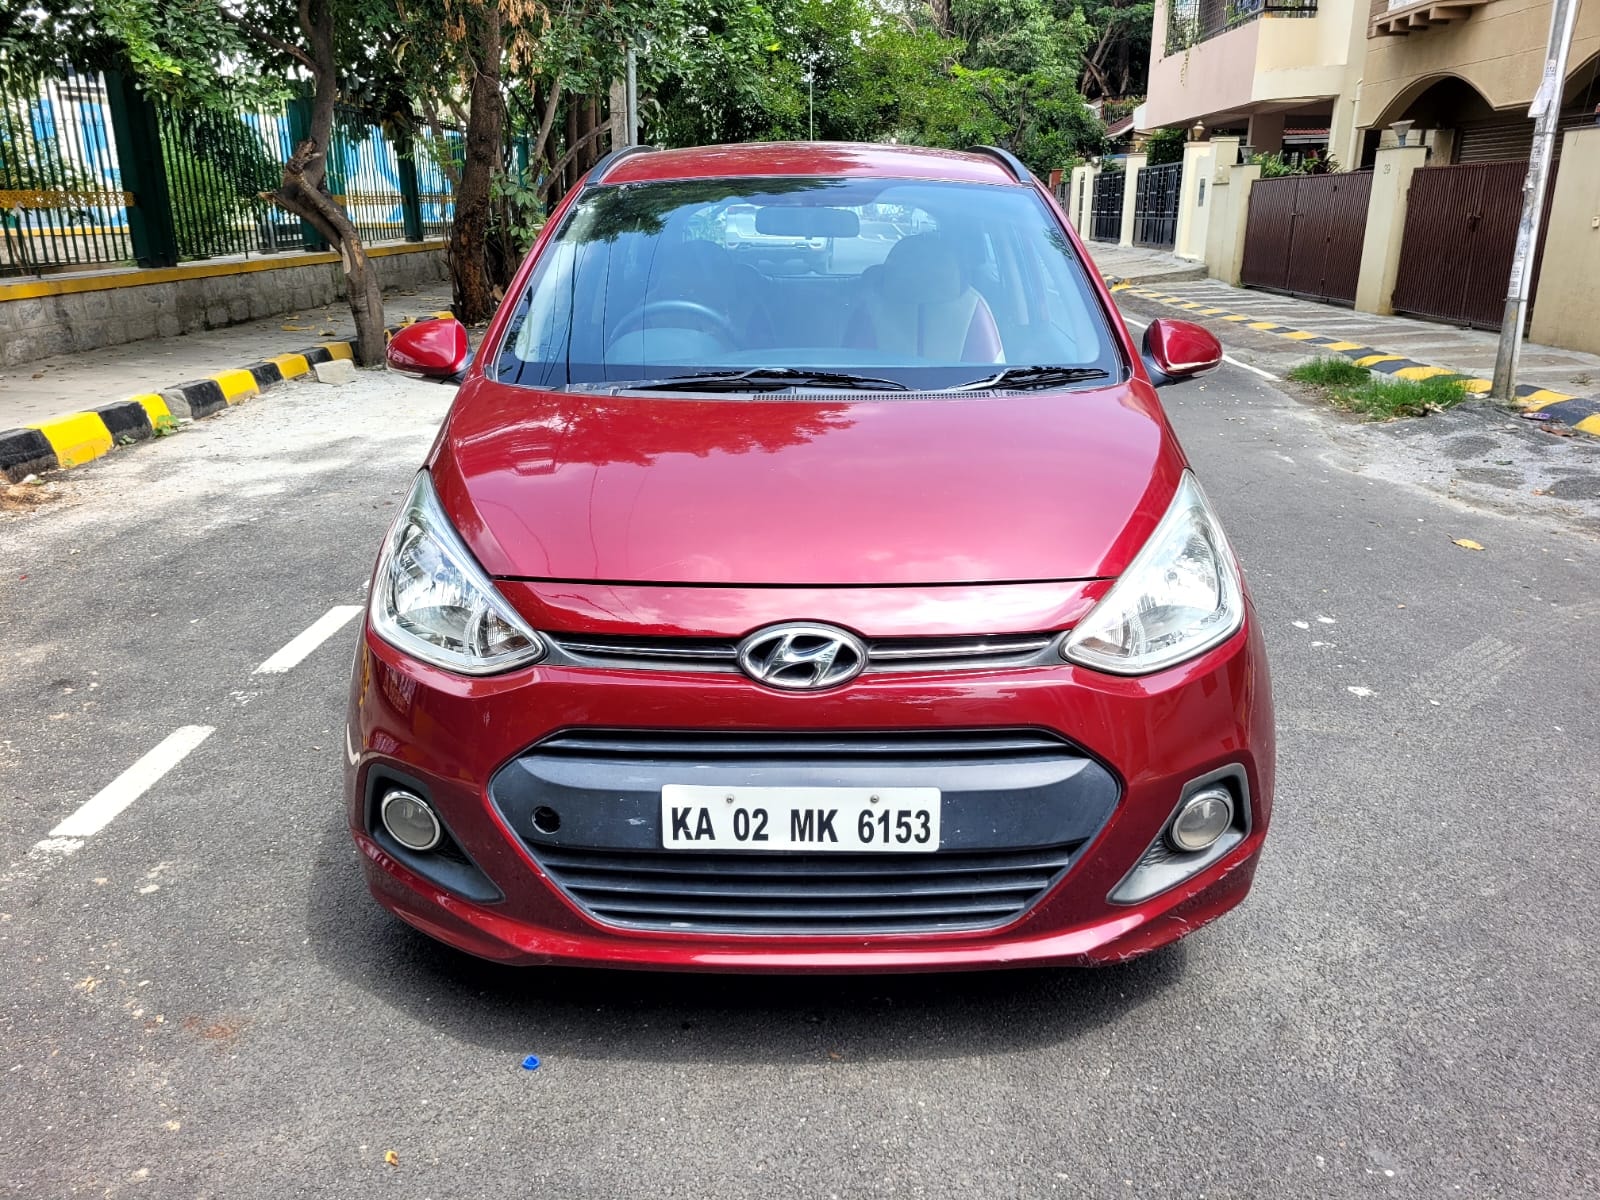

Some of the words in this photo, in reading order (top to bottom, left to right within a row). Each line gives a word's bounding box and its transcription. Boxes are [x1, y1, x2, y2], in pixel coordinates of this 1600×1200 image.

[671, 807, 716, 841] KA
[733, 807, 769, 842] 02
[790, 808, 839, 843] MK
[857, 809, 931, 844] 6153
